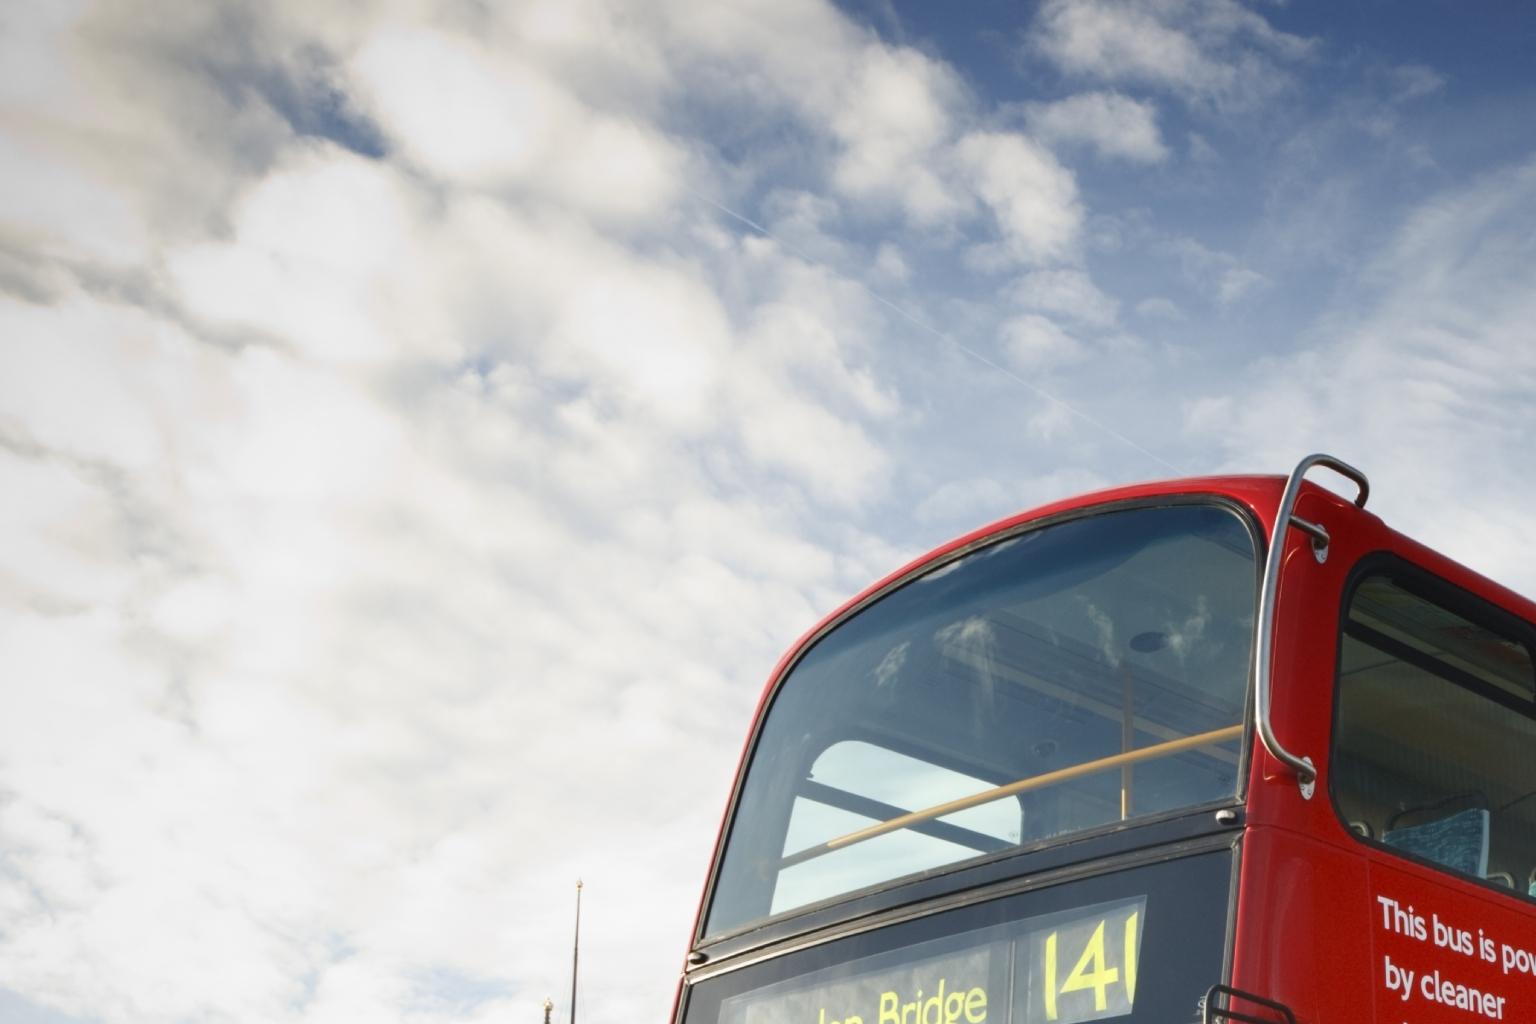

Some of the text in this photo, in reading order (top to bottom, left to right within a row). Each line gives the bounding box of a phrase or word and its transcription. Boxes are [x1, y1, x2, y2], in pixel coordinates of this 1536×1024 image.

[1377, 896, 1428, 941] This
[1433, 914, 1474, 957] bus
[1479, 929, 1496, 963] is
[1045, 911, 1138, 1021] 141
[1384, 955, 1505, 1020] by cleaner
